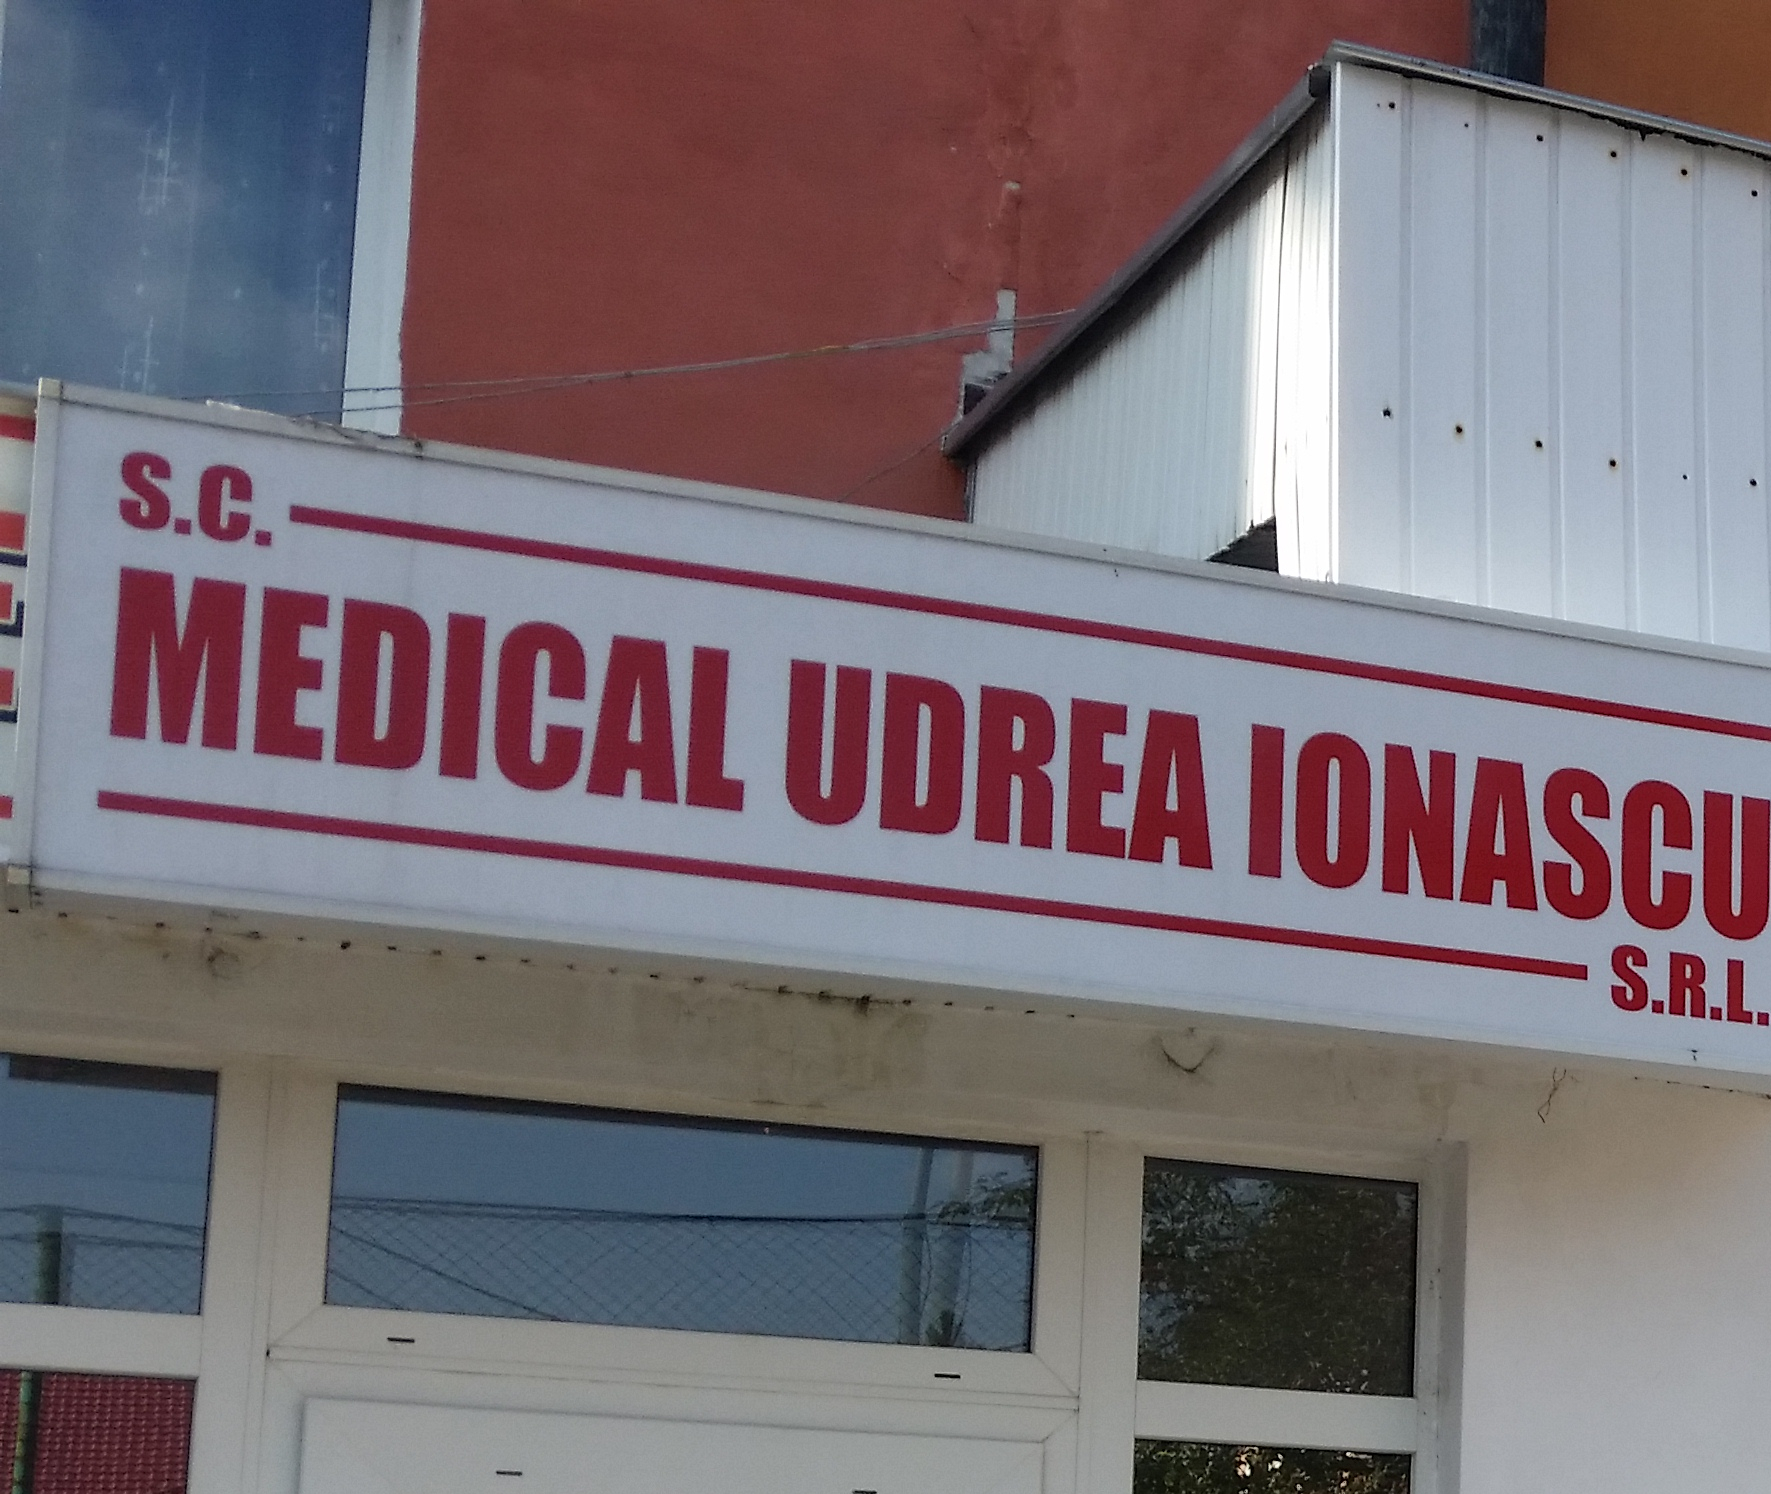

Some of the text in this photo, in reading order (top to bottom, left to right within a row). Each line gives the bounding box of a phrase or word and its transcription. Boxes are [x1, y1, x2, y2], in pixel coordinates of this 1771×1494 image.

[118, 452, 273, 546] S.C.
[110, 566, 744, 813] MEDICAL
[785, 661, 1212, 870] UDREA
[1247, 725, 1771, 942] IONASCU
[1610, 944, 1771, 1027] S.R.L.
